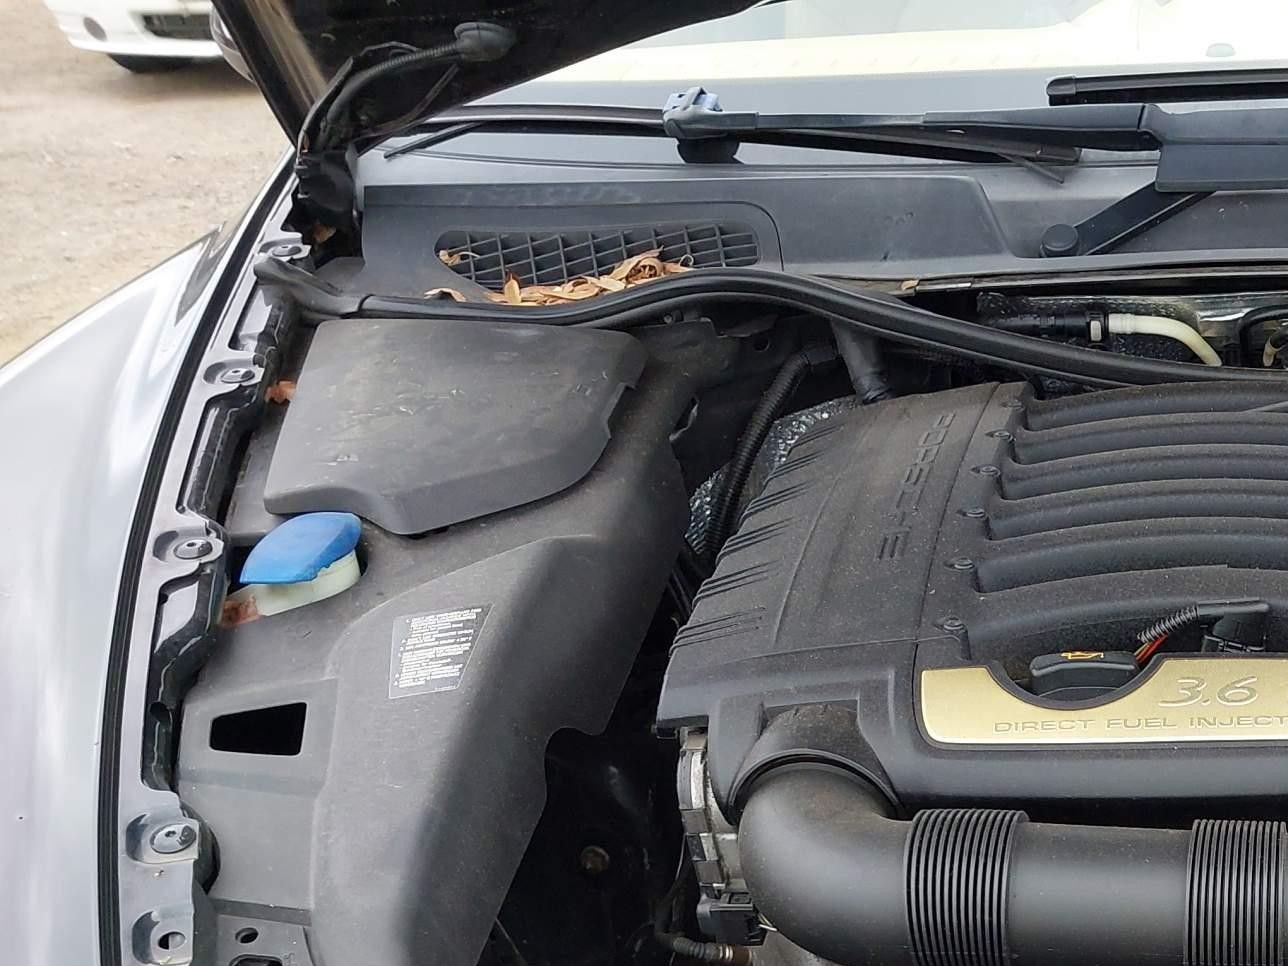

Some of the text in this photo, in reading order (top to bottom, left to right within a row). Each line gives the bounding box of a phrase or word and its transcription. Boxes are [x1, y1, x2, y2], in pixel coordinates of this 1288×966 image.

[1158, 675, 1260, 708] 3.6
[994, 718, 1094, 733] DIRECT
[1106, 716, 1177, 730] FUEL
